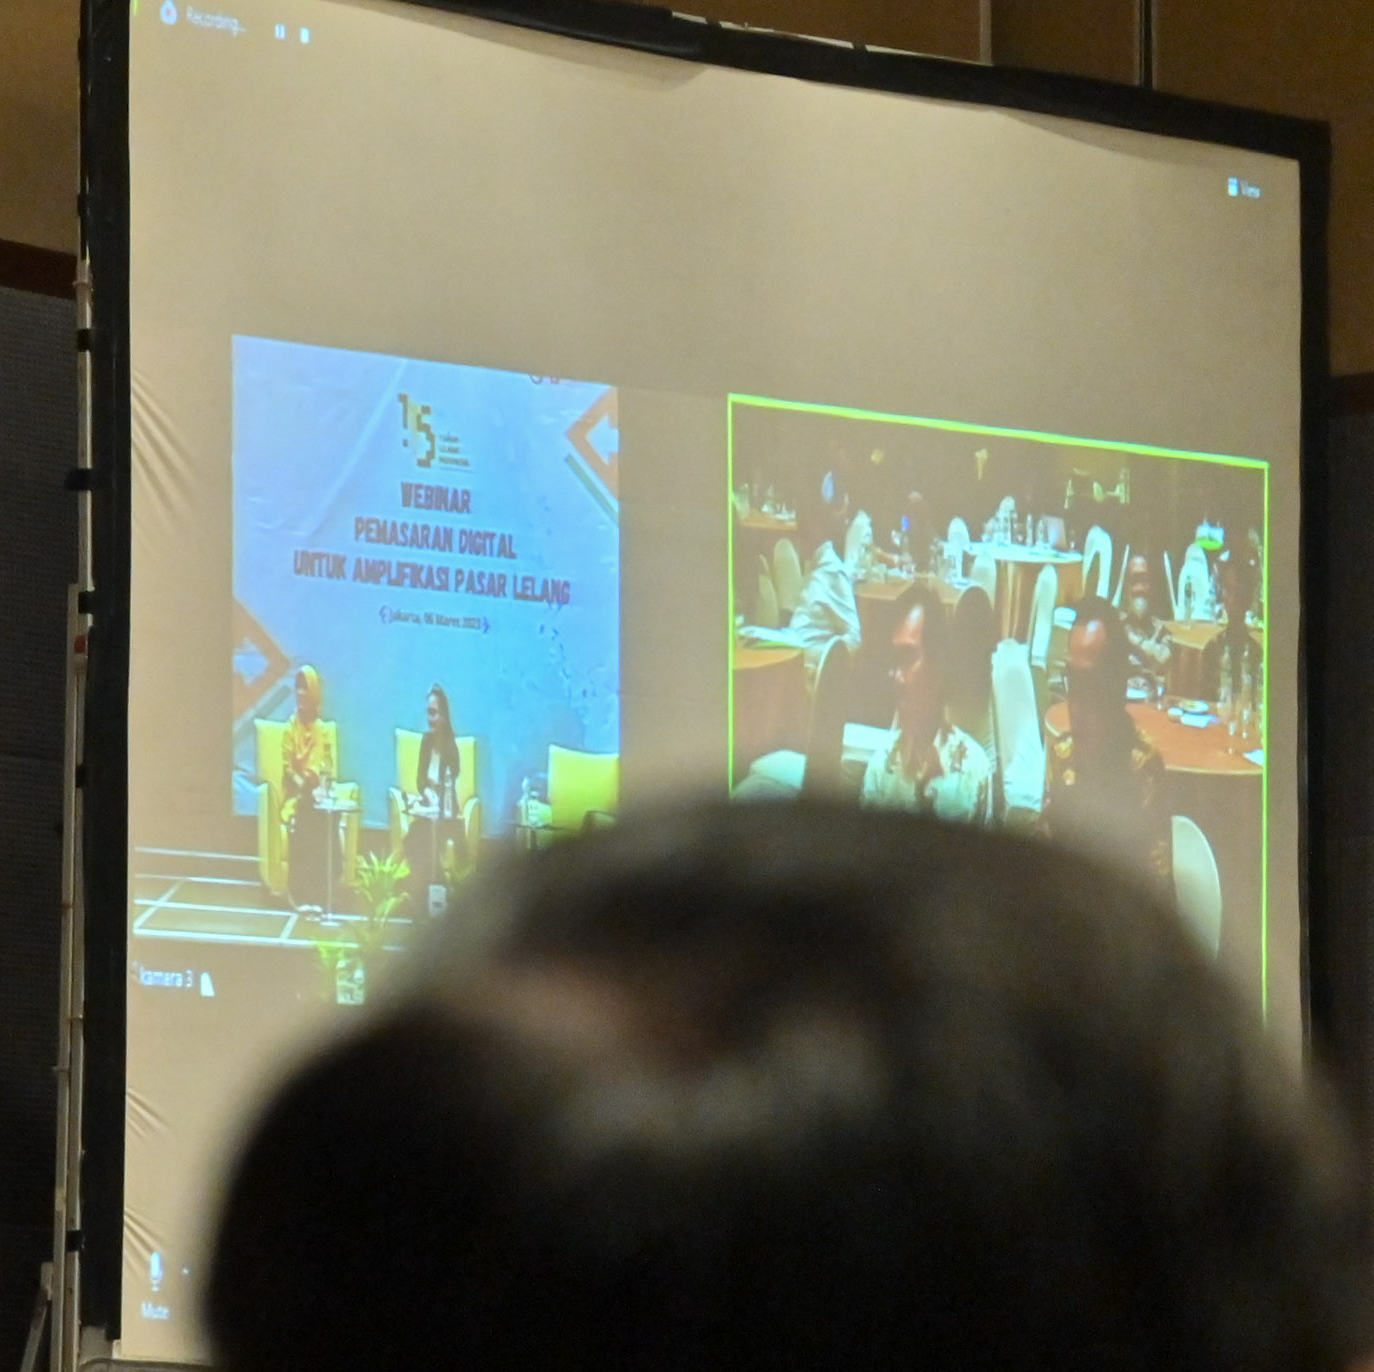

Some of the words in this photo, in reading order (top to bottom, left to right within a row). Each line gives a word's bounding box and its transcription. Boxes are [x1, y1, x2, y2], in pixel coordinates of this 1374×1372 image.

[401, 481, 471, 514] WEBINAR
[355, 516, 453, 552] PEMASARAN
[459, 529, 517, 559] DIGITAL
[294, 549, 347, 580] UNTUK
[454, 568, 507, 598] PASAR
[513, 574, 571, 605] LELANG
